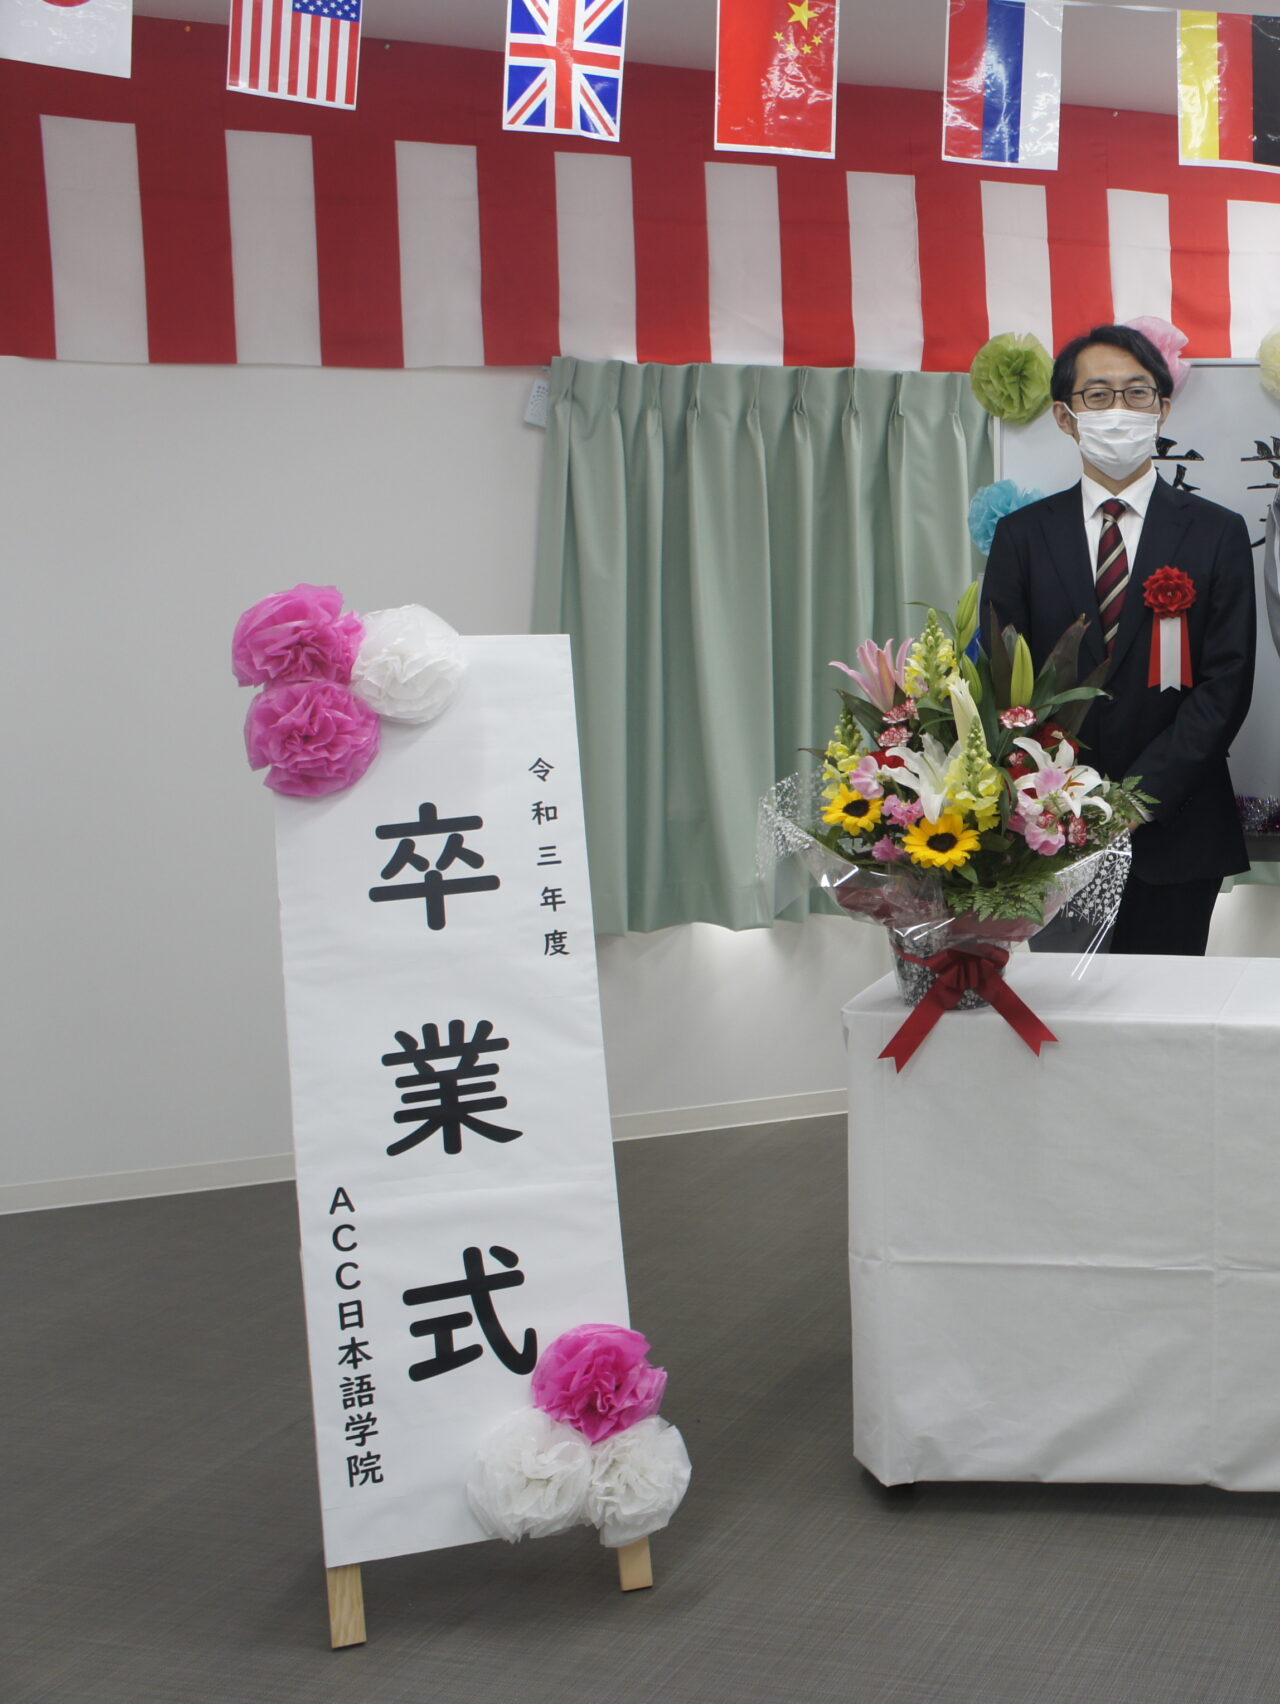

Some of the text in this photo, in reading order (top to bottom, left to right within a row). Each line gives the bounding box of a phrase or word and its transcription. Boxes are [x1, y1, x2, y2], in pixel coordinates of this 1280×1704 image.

[528, 757, 570, 957] 令和三年度
[368, 802, 538, 1383] 卒業式
[329, 1186, 384, 1488] ACC日本語学院
